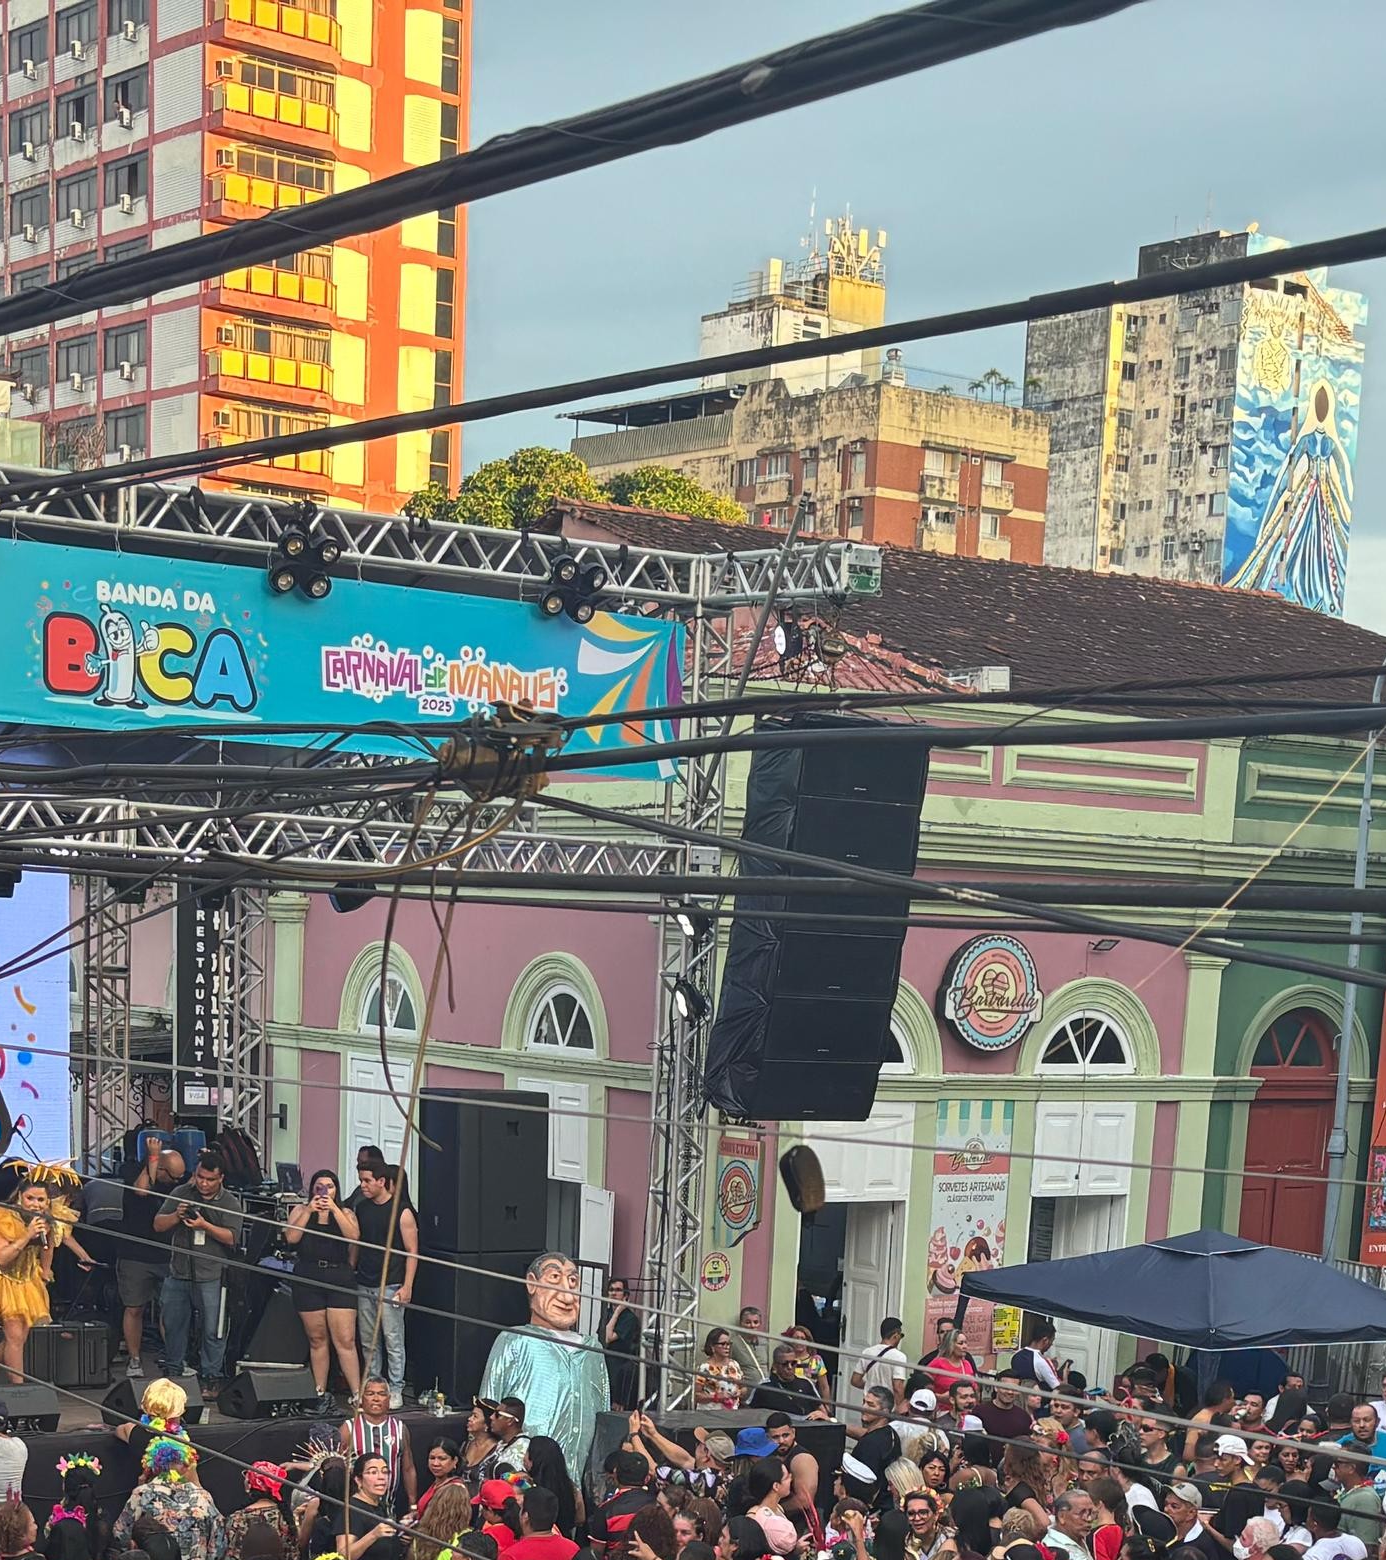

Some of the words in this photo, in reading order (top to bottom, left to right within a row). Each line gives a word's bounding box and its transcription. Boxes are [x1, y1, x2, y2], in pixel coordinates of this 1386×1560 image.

[96, 580, 178, 611] BANDA
[184, 590, 217, 614] DA
[324, 649, 423, 695] CARNAVAL
[425, 666, 447, 688] de
[448, 662, 556, 710] MANAUS
[421, 698, 453, 713] 2025
[195, 908, 206, 1077] RESTAURANTE
